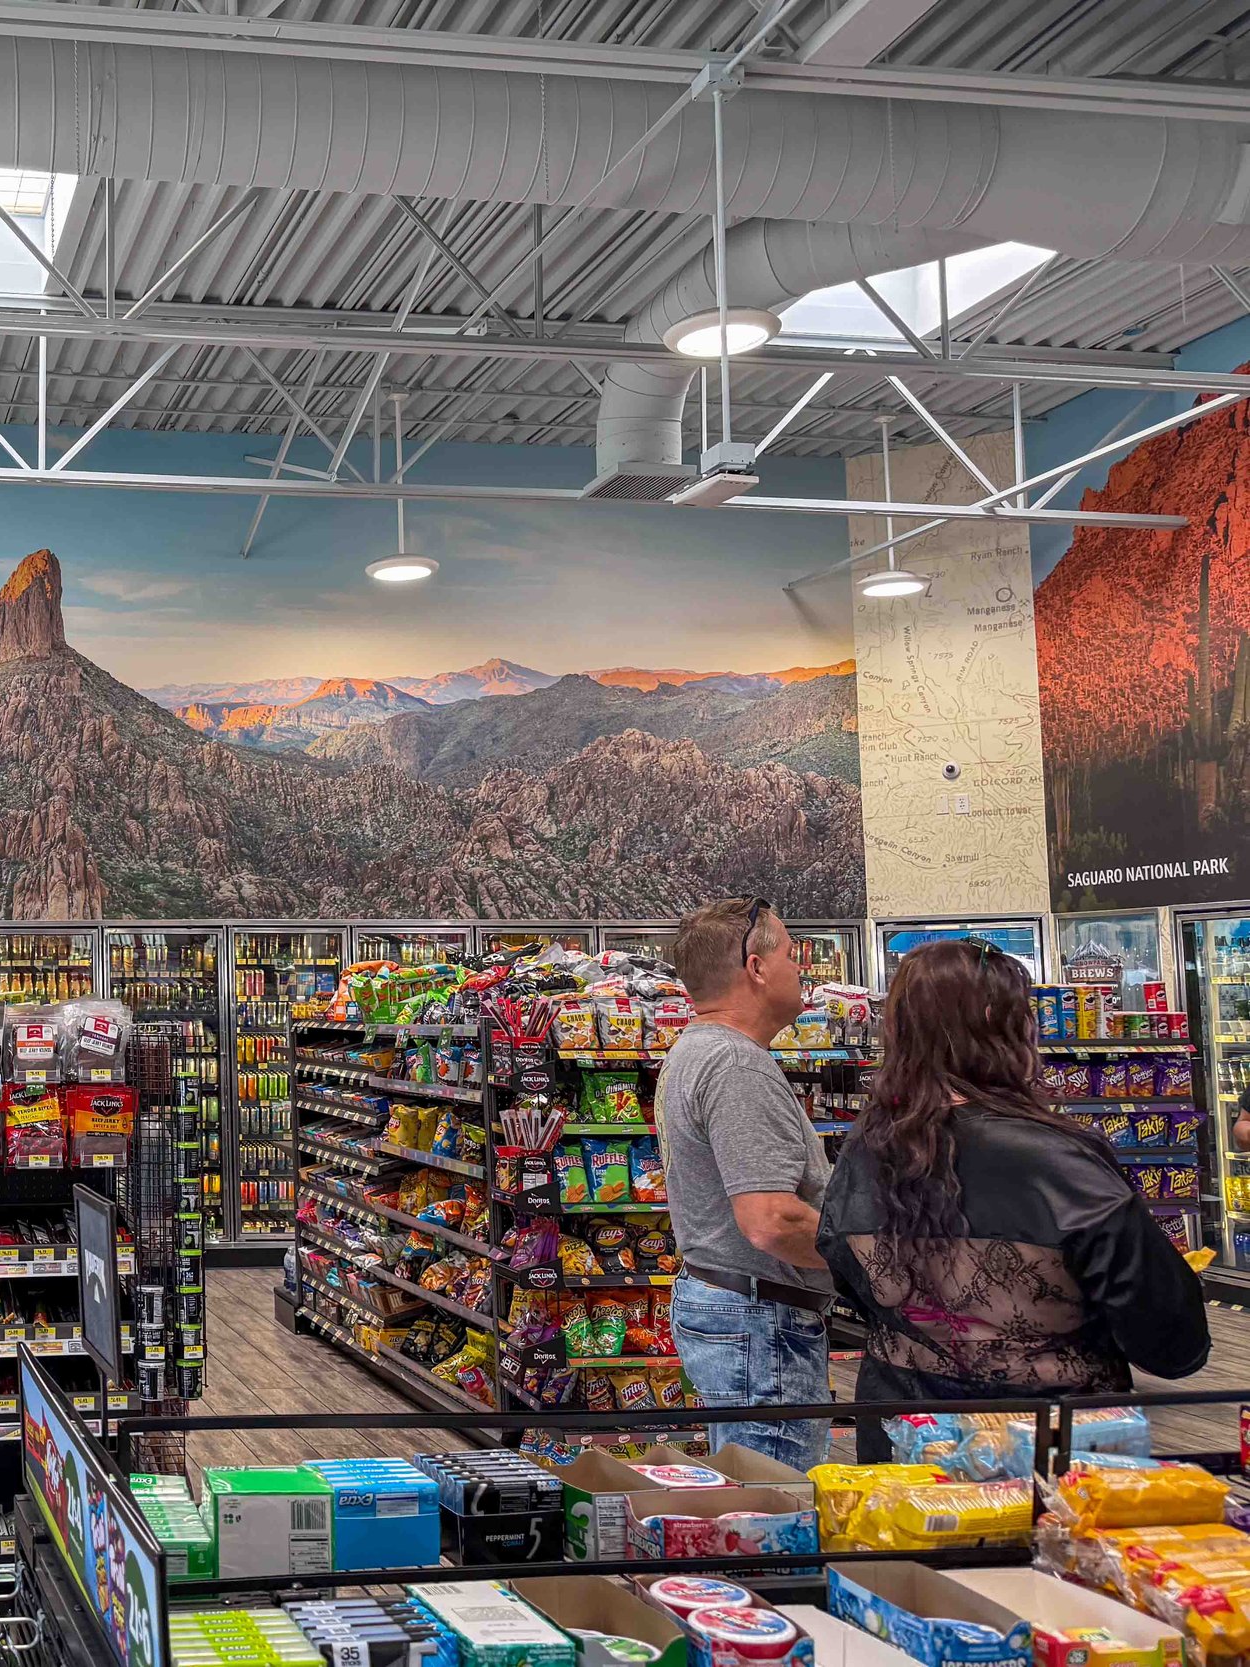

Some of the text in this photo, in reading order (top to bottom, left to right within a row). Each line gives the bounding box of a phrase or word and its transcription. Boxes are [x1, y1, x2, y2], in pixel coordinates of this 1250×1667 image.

[966, 603, 1016, 616] Manganese
[964, 640, 979, 665] ROAD
[1067, 857, 1229, 888] SAGUARO NATIONAL PARK
[1071, 967, 1114, 979] BREWS
[566, 1015, 586, 1023] CHAOS
[616, 1018, 636, 1026] CHAOS
[534, 1075, 550, 1083] LINK'S
[1067, 1069, 1089, 1088] STIX
[90, 1099, 106, 1108] JACK
[1135, 1115, 1165, 1142] Takis
[591, 1153, 627, 1167] RUFFLES
[1138, 1167, 1162, 1192] Takis
[1167, 1169, 1195, 1192] Takis
[527, 1197, 550, 1205] Doritos
[541, 1272, 558, 1280] LINK'S
[591, 1305, 625, 1322] Cheetos
[533, 1352, 556, 1361] Doritos
[621, 1379, 648, 1400] Fritos
[338, 1490, 374, 1507] Extra
[485, 1517, 543, 1560] PEPPERMINT 5
[340, 1647, 360, 1660] 35
